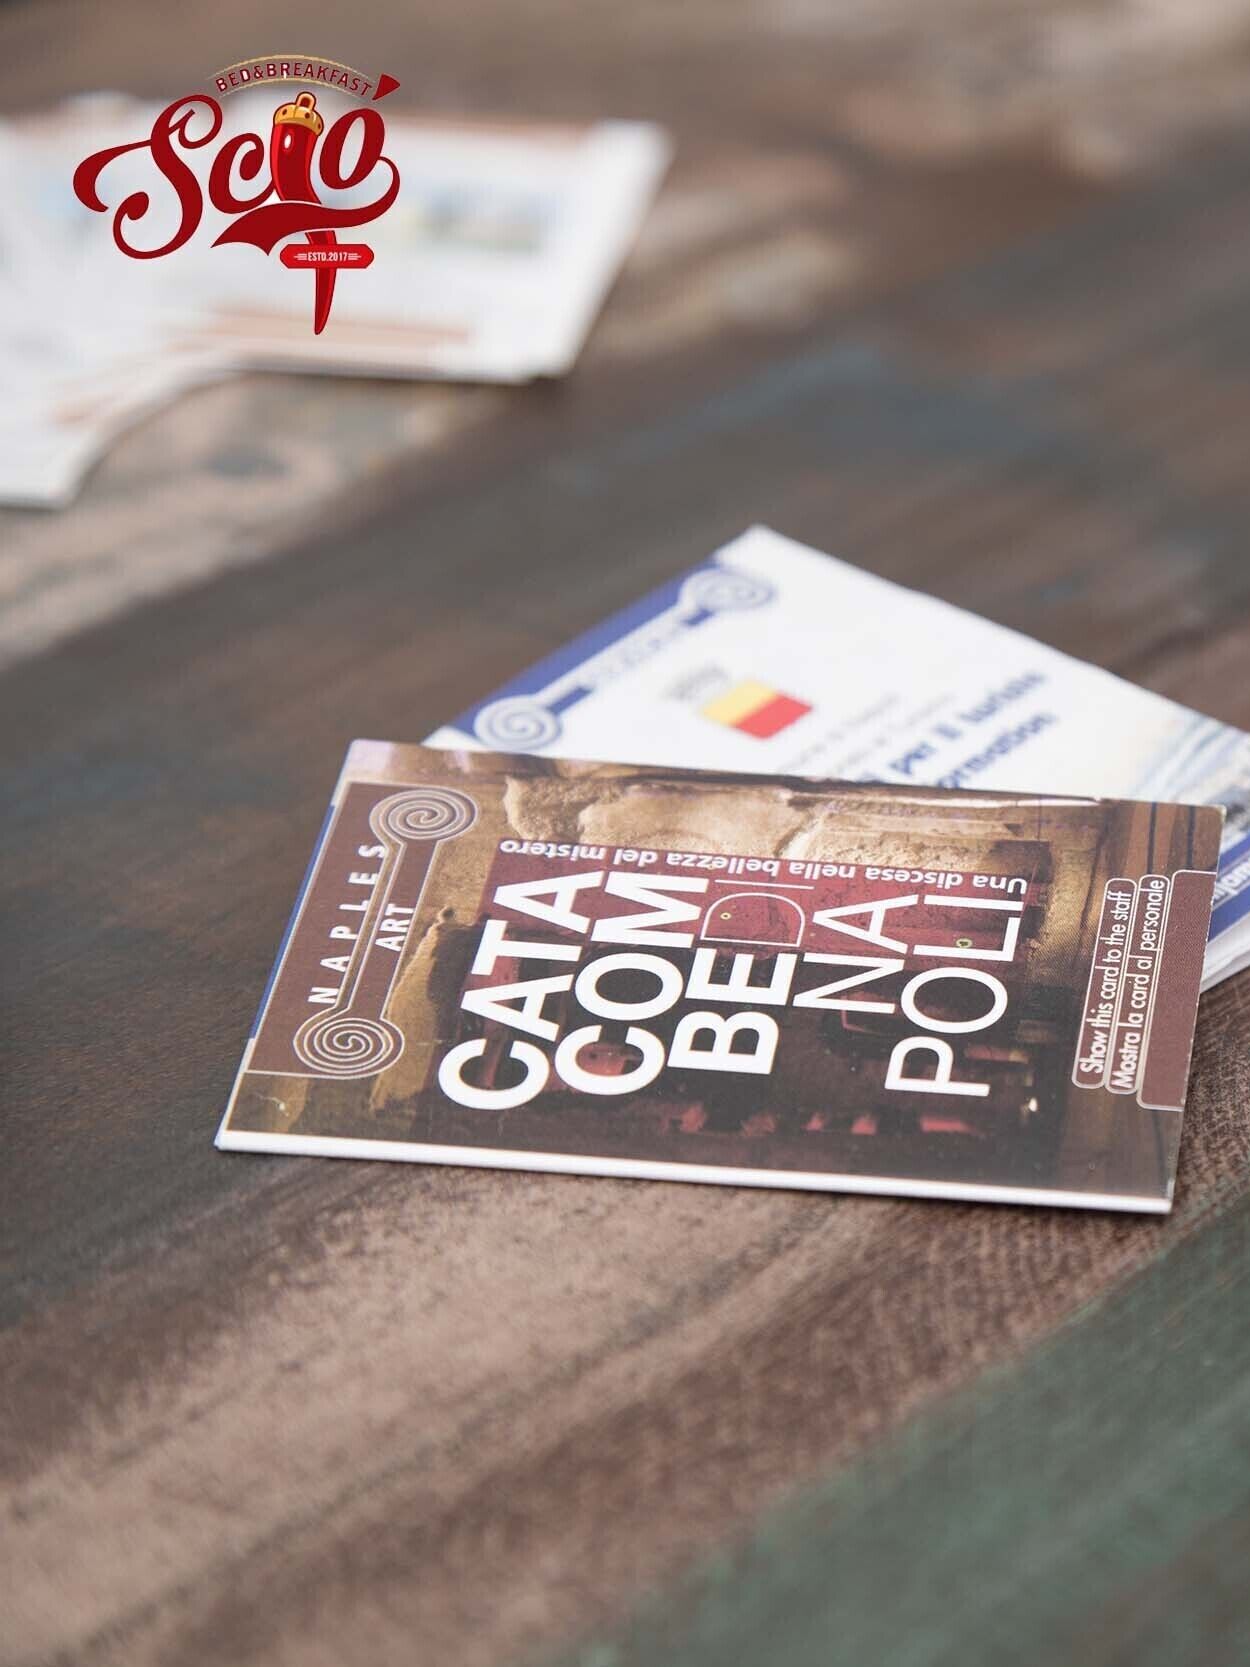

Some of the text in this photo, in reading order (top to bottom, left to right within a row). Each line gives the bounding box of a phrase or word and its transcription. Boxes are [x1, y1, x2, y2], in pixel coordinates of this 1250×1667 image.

[307, 844, 388, 1005] NAPLES
[375, 903, 414, 952] ART
[500, 839, 1028, 894] Una discesa nella bellezza del mistero
[792, 894, 919, 1014] NA
[438, 870, 604, 1110] CATA
[555, 870, 709, 1095] COM
[884, 894, 1024, 1097] POLI
[1079, 890, 1132, 1074] Show this card to the staff
[1111, 880, 1165, 1089] Mostra la card al personale
